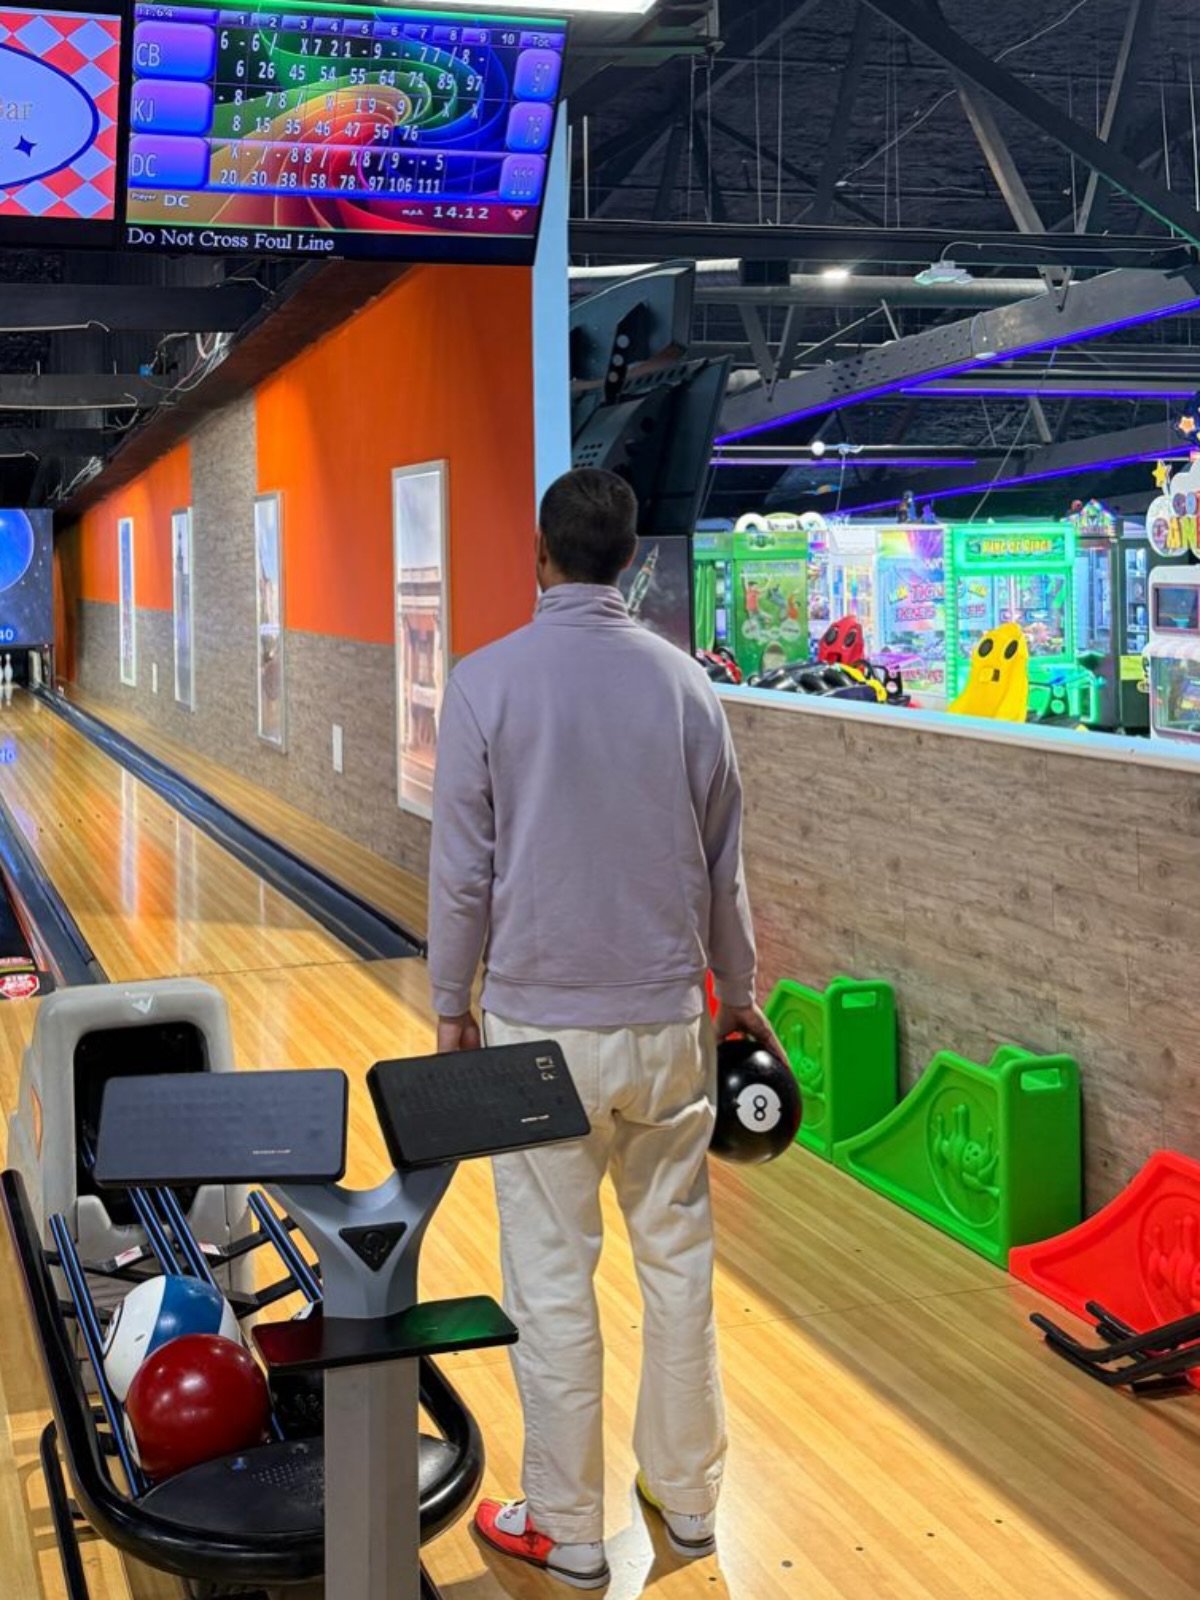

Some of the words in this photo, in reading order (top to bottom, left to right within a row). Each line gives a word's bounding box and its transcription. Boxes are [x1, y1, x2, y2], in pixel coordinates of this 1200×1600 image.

[135, 42, 161, 67] CB
[220, 31, 229, 49] 6
[252, 33, 260, 51] 6
[301, 38, 308, 55] X
[314, 39, 322, 55] 7
[330, 40, 338, 56] 2
[344, 41, 351, 58] 1
[374, 42, 382, 59] 9
[420, 47, 427, 62] 7
[433, 48, 441, 63] 7
[462, 49, 470, 64] 8
[502, 33, 515, 45] 10
[236, 60, 244, 77] 6
[258, 62, 275, 78] 26
[289, 64, 306, 81] 45
[320, 66, 337, 82] 54
[350, 68, 366, 84] 55
[379, 70, 395, 86] 64
[437, 74, 453, 90] 89
[466, 75, 482, 91] 97
[0, 102, 33, 120] ar
[133, 99, 154, 122] KJ
[235, 89, 243, 106] 8
[265, 91, 273, 108] 7
[278, 92, 287, 109] 8
[355, 97, 362, 112] 1
[368, 97, 376, 113] 9
[397, 99, 405, 116] 9
[442, 101, 450, 117] X
[471, 103, 479, 119] X
[232, 115, 241, 131] 8
[255, 117, 271, 133] 15
[284, 118, 301, 135] 35
[315, 120, 331, 136] 46
[344, 122, 360, 138] 47
[374, 123, 390, 139] 56
[402, 125, 418, 141] 76
[130, 153, 158, 177] DC
[231, 143, 239, 160] X
[291, 146, 299, 163] 8
[304, 147, 312, 163] 8
[349, 150, 358, 167] X
[362, 150, 371, 167] 8
[391, 152, 400, 169] 9
[435, 154, 444, 170] 5
[220, 168, 237, 185] 20
[251, 170, 267, 187] 30
[280, 171, 297, 188] 38
[310, 173, 326, 190] 58
[339, 174, 355, 191] 78
[368, 175, 384, 191] 97
[389, 177, 412, 193] 106
[417, 178, 440, 194] 111
[164, 194, 191, 208] DC
[433, 206, 489, 220] 14.12
[127, 227, 155, 245] Do
[161, 229, 195, 247] Not
[200, 230, 249, 248] Cross
[254, 232, 292, 250] Foul
[298, 234, 335, 251] Line
[752, 1095, 768, 1121] 8
